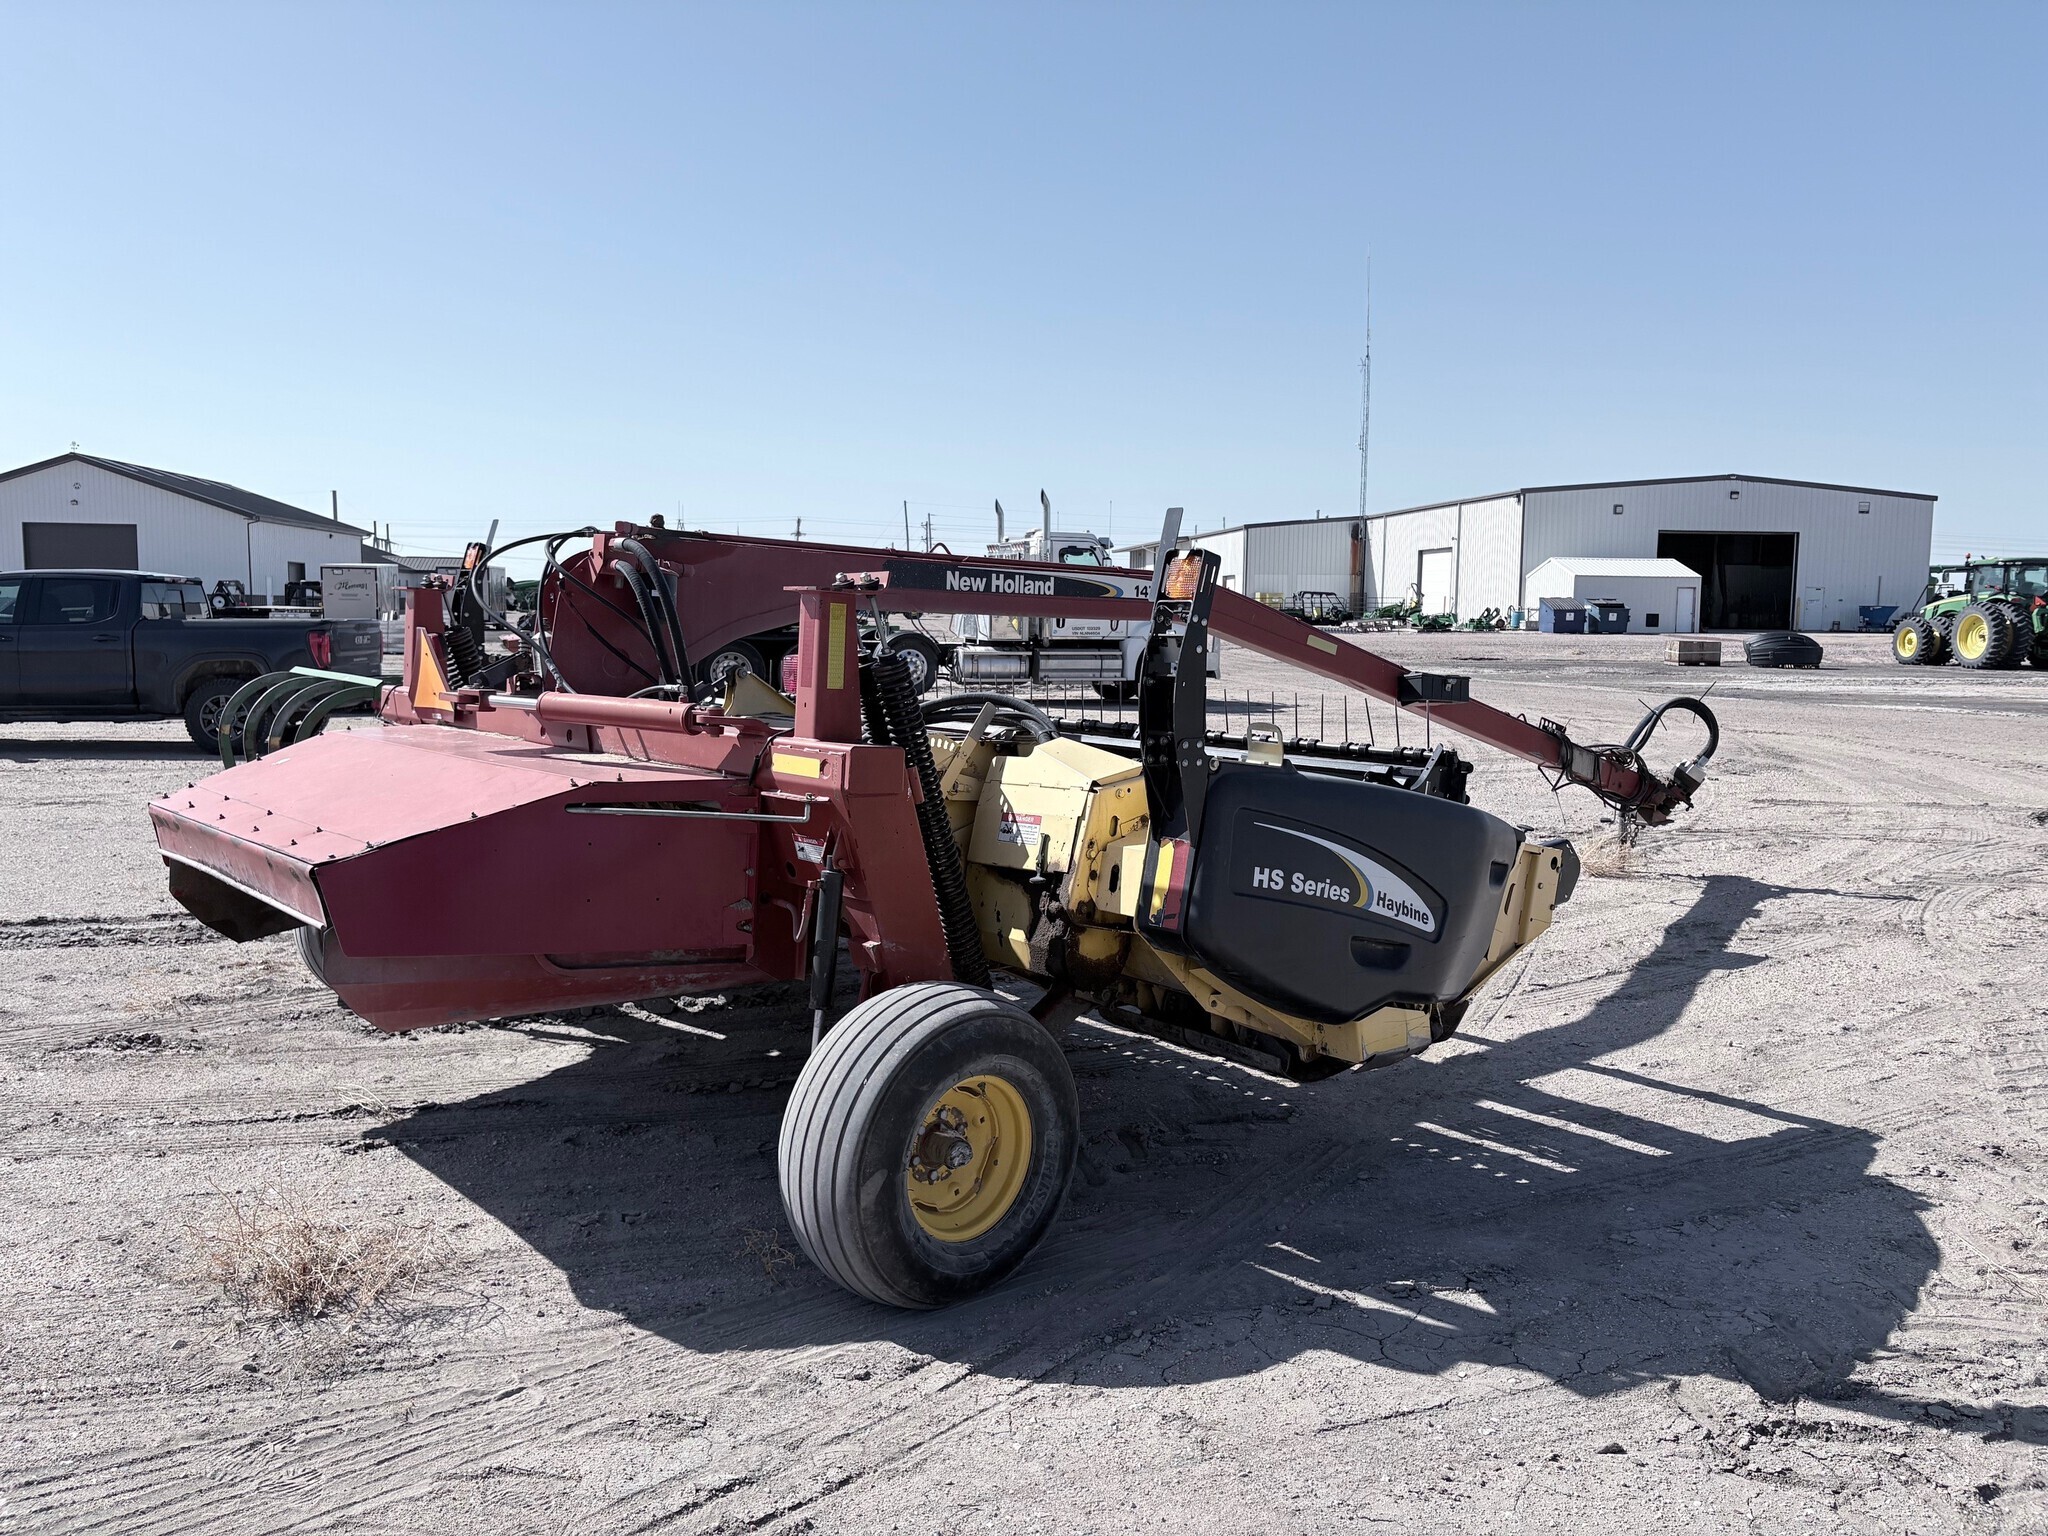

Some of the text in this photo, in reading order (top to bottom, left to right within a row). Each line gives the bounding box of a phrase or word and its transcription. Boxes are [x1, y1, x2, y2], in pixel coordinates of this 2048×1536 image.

[946, 570, 1152, 598] New Holland 14
[1252, 866, 1430, 925] HS Series Haybine
